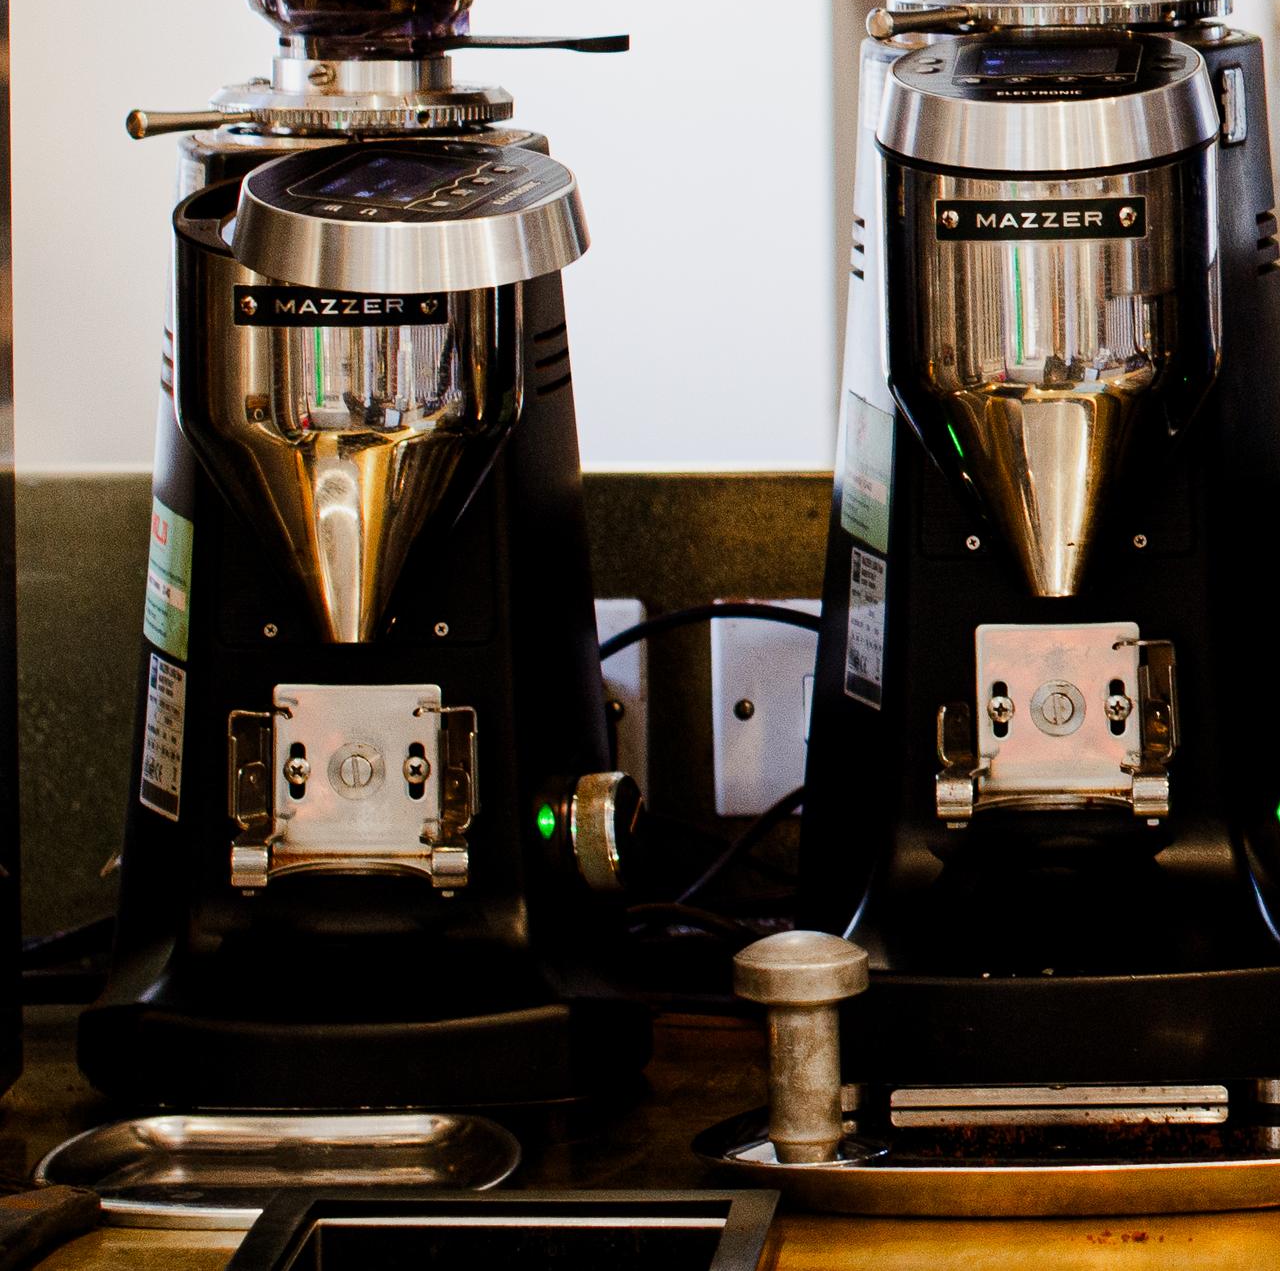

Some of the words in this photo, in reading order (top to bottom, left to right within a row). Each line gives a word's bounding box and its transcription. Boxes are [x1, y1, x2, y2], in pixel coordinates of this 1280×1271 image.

[996, 89, 1083, 97] ELECTRONIC
[975, 211, 1105, 228] MAZZER
[274, 296, 406, 316] MAZZER
